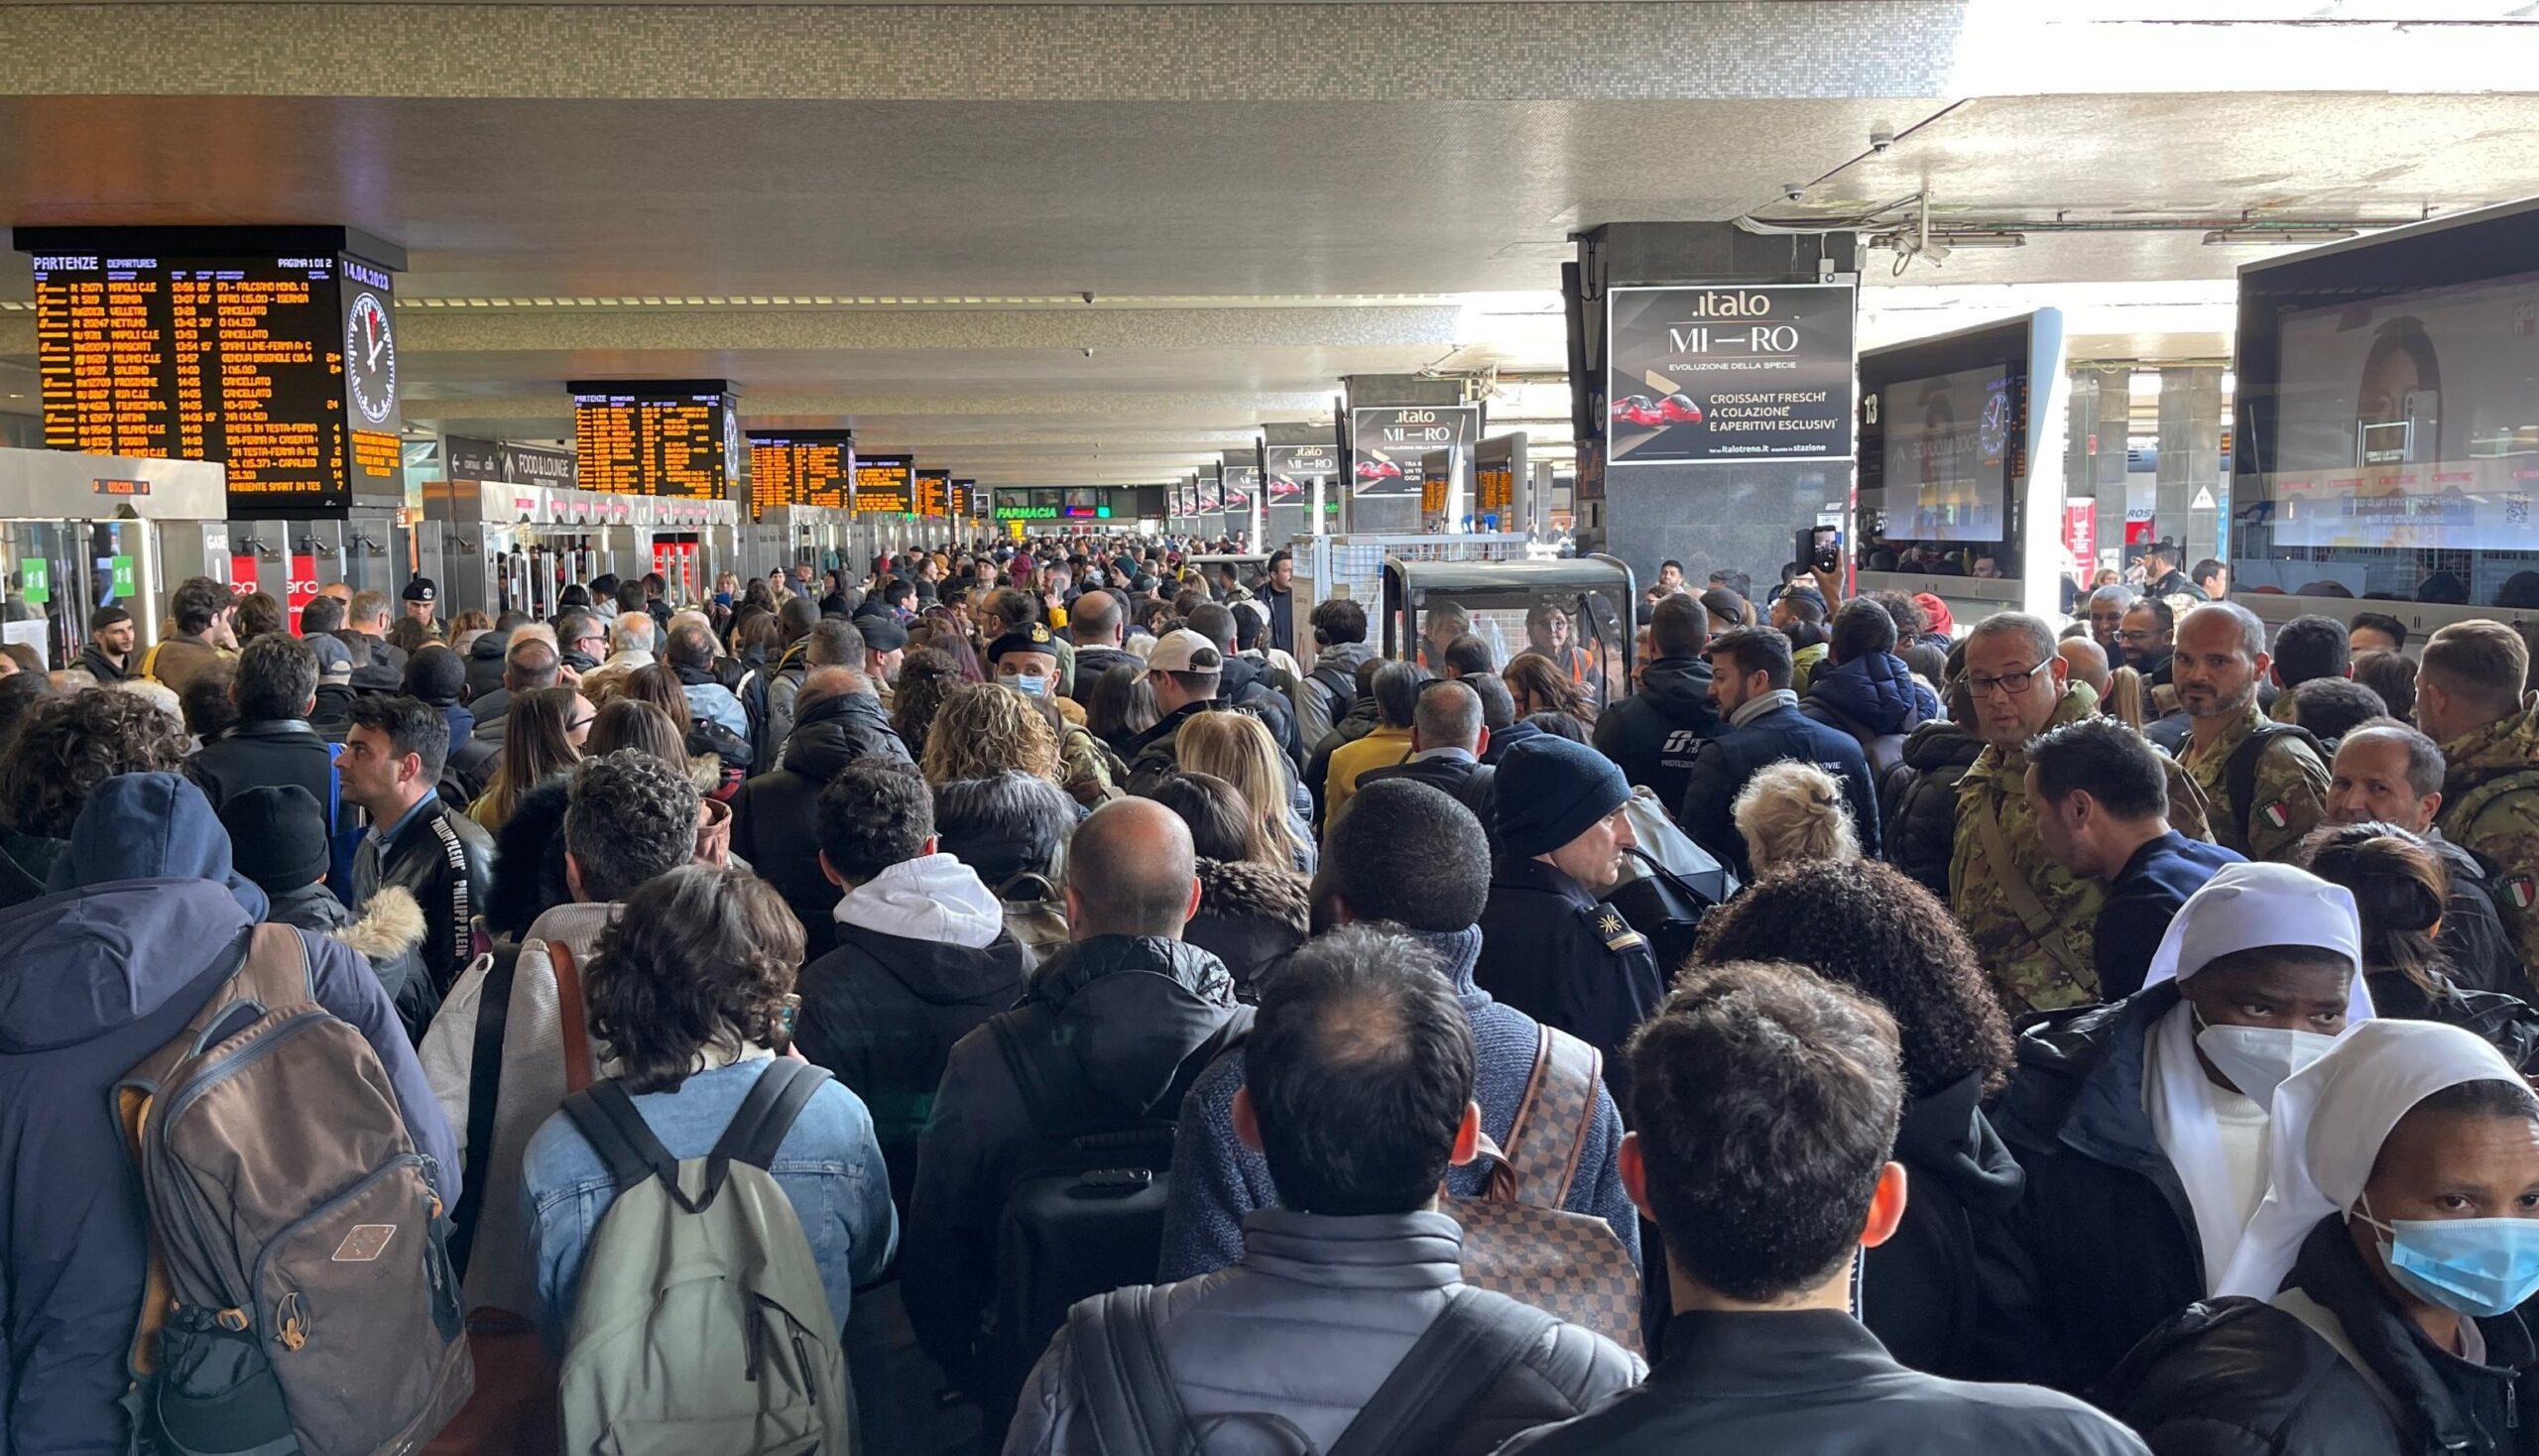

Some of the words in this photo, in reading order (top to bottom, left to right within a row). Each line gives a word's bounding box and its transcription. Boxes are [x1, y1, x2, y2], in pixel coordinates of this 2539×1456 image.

[34, 257, 98, 270] PARTENZE
[107, 259, 157, 268] DEPARTURES
[278, 259, 307, 268] PAGINA
[325, 259, 332, 268] 2
[344, 261, 389, 291] 14.04.2023
[108, 283, 137, 292] NAPOLI
[236, 283, 274, 292] FALCIANO
[173, 295, 194, 303] 13:07
[277, 295, 309, 303] ISERNIA
[110, 306, 147, 315] VELLETRI
[218, 306, 267, 315] CANCELLATO
[111, 318, 147, 327] NETTUNO
[175, 318, 196, 327] 13:42
[111, 330, 140, 339] NAPOLI
[175, 330, 198, 339] 13:53
[219, 330, 268, 339] CANCELLATO
[177, 342, 198, 351] 13:54
[113, 354, 143, 363] MILANO
[177, 353, 198, 363] 13:57
[113, 365, 149, 375] SALERNO
[178, 366, 200, 375] 14:00
[179, 377, 200, 387] 14:05
[222, 377, 272, 387] CANCELLATO
[179, 389, 202, 399] 14:05
[222, 389, 272, 399] CANCELLATO
[1710, 393, 1775, 405] CROISSANT
[180, 401, 202, 411] 14:05
[327, 400, 339, 409] 24
[1865, 394, 1877, 425] 13
[117, 414, 147, 423] LATINA
[181, 413, 202, 423] 14:06
[1710, 409, 1718, 418] A
[117, 425, 147, 434] MILANO
[181, 425, 202, 433] 14:10
[1710, 423, 1717, 431] E
[1720, 421, 1775, 431] APERITIVI
[182, 436, 202, 445] 14:10
[333, 435, 341, 444] 9
[120, 448, 148, 458] MILANO
[182, 447, 204, 456] 14:10
[334, 447, 341, 456] 2
[279, 459, 317, 468] CAPALBIO
[333, 470, 343, 479] 14
[229, 482, 268, 492] AMBIENTE
[269, 482, 294, 492] SMART
[306, 482, 321, 491] TES
[997, 508, 1057, 518] FARMACIA
[206, 535, 227, 549] GATE
[453, 879, 468, 924] PHILIPP
[454, 926, 468, 956] PLEIN
